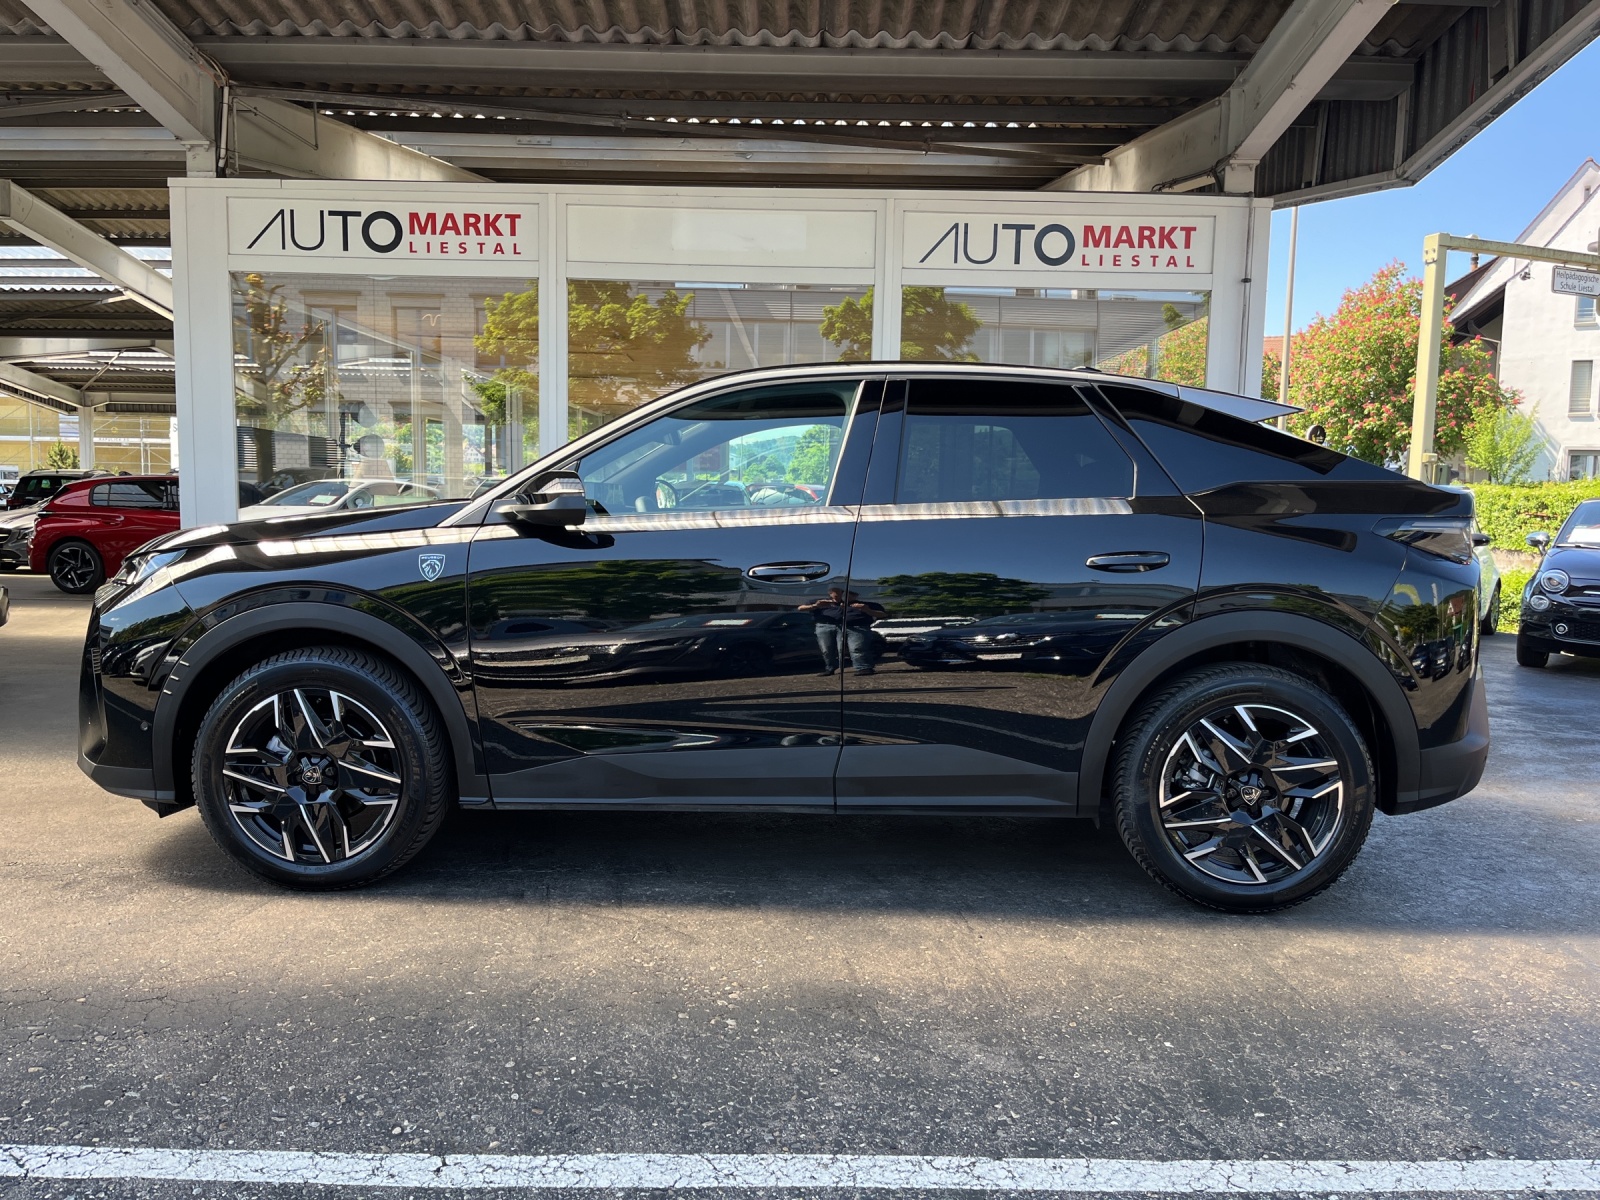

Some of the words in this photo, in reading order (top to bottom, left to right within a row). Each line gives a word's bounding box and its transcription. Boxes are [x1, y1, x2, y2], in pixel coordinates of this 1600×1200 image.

[247, 208, 403, 253] AUTO
[408, 211, 522, 237] MARKT
[409, 241, 522, 255] LIESTAL
[918, 222, 1076, 266] AUTO
[1082, 225, 1197, 249] MARKT
[1081, 254, 1195, 268] LIESTAL
[1556, 270, 1600, 283] Heilpädagogische
[1560, 282, 1576, 290] Schule
[1578, 284, 1594, 292] Liestal
